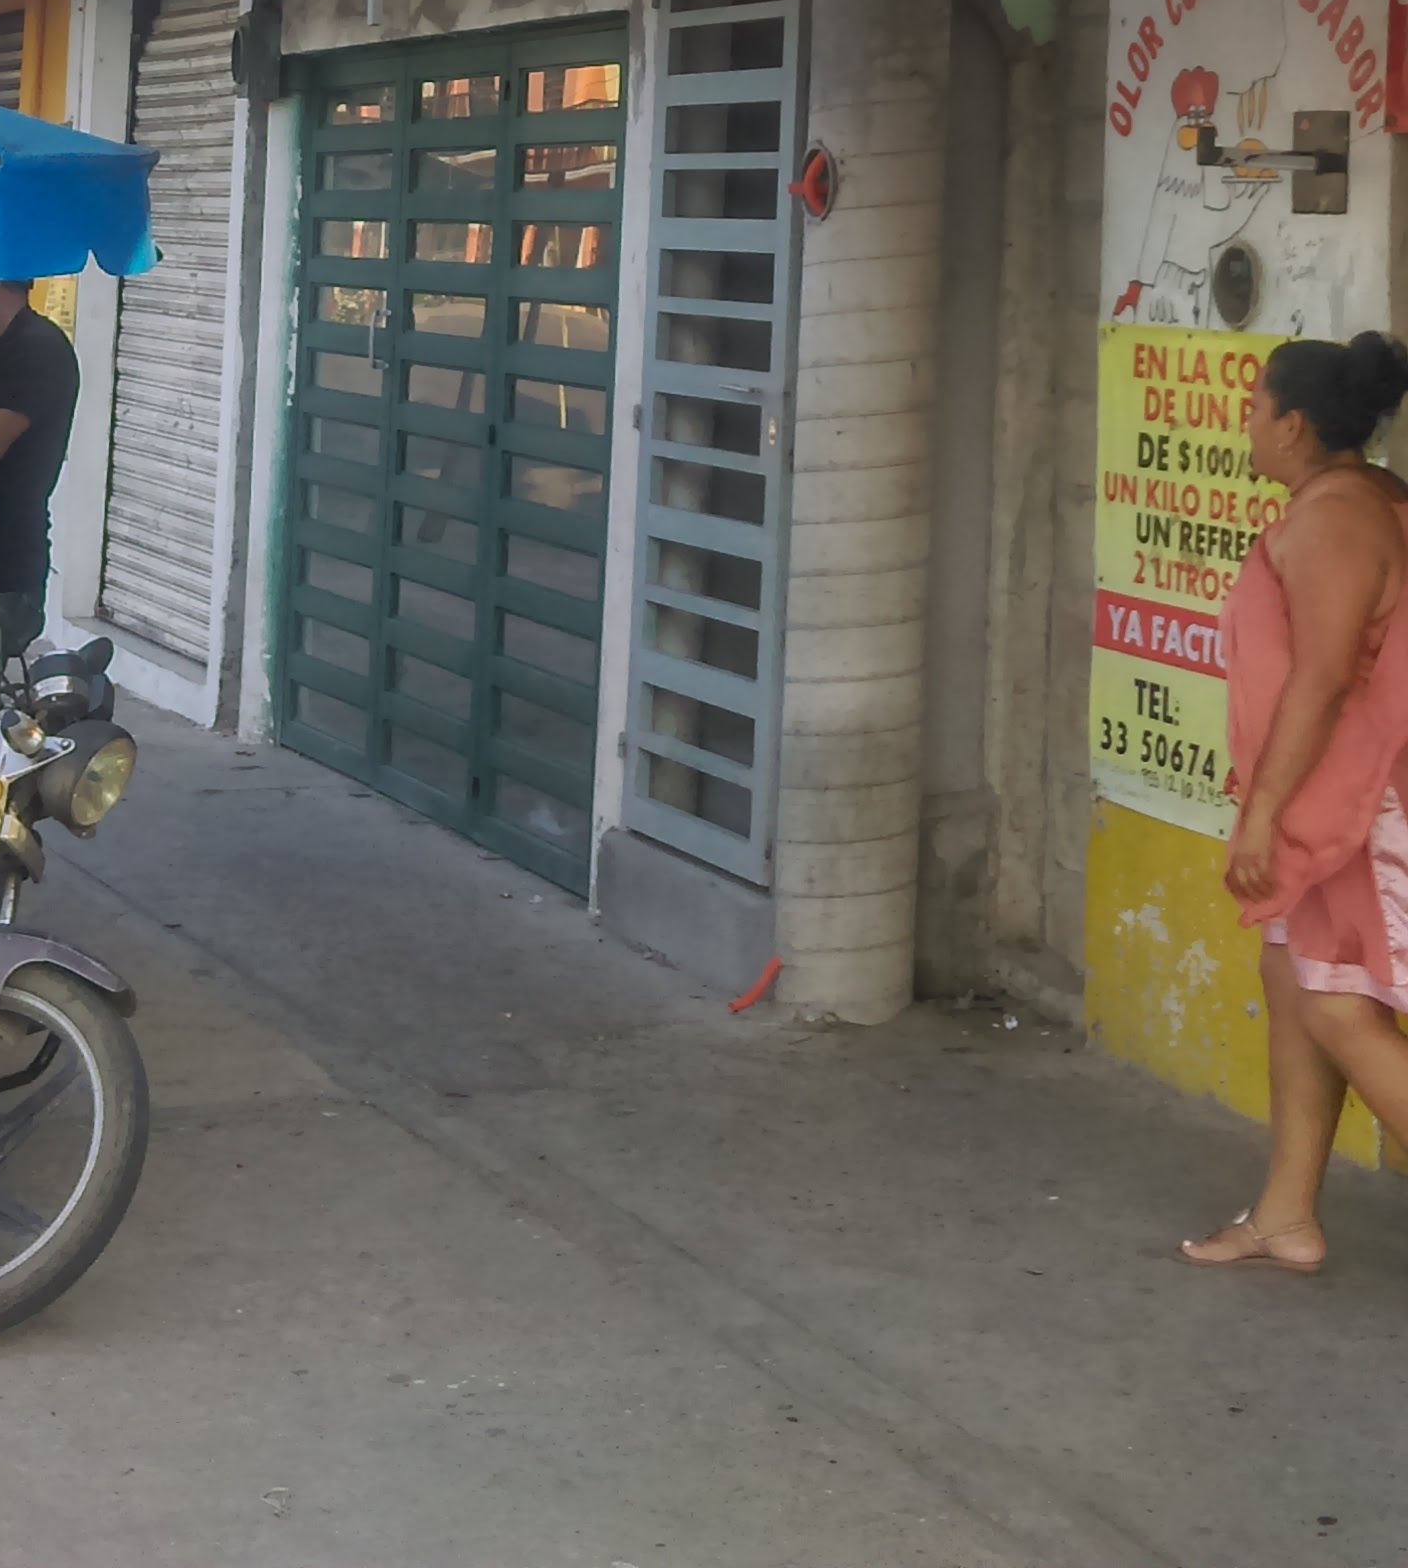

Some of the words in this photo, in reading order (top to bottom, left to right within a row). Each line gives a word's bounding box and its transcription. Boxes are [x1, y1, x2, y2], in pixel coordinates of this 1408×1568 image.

[1109, 15, 1164, 138] OLOR
[1133, 343, 1168, 381] EN
[1178, 347, 1211, 386] LA
[1144, 385, 1176, 425] DE
[1186, 390, 1229, 432] UN
[1137, 432, 1170, 472] DE
[1178, 438, 1259, 482] $100/
[1104, 471, 1138, 505] UN
[1145, 478, 1201, 518] KILO
[1209, 488, 1238, 523] DE
[1246, 496, 1288, 528] CO
[1136, 513, 1171, 548] UN
[1133, 550, 1146, 584] 2
[1107, 604, 1144, 647] YA
[1133, 678, 1180, 726] TEL:
[1100, 717, 1128, 755] 33
[1140, 730, 1216, 782] 50674
